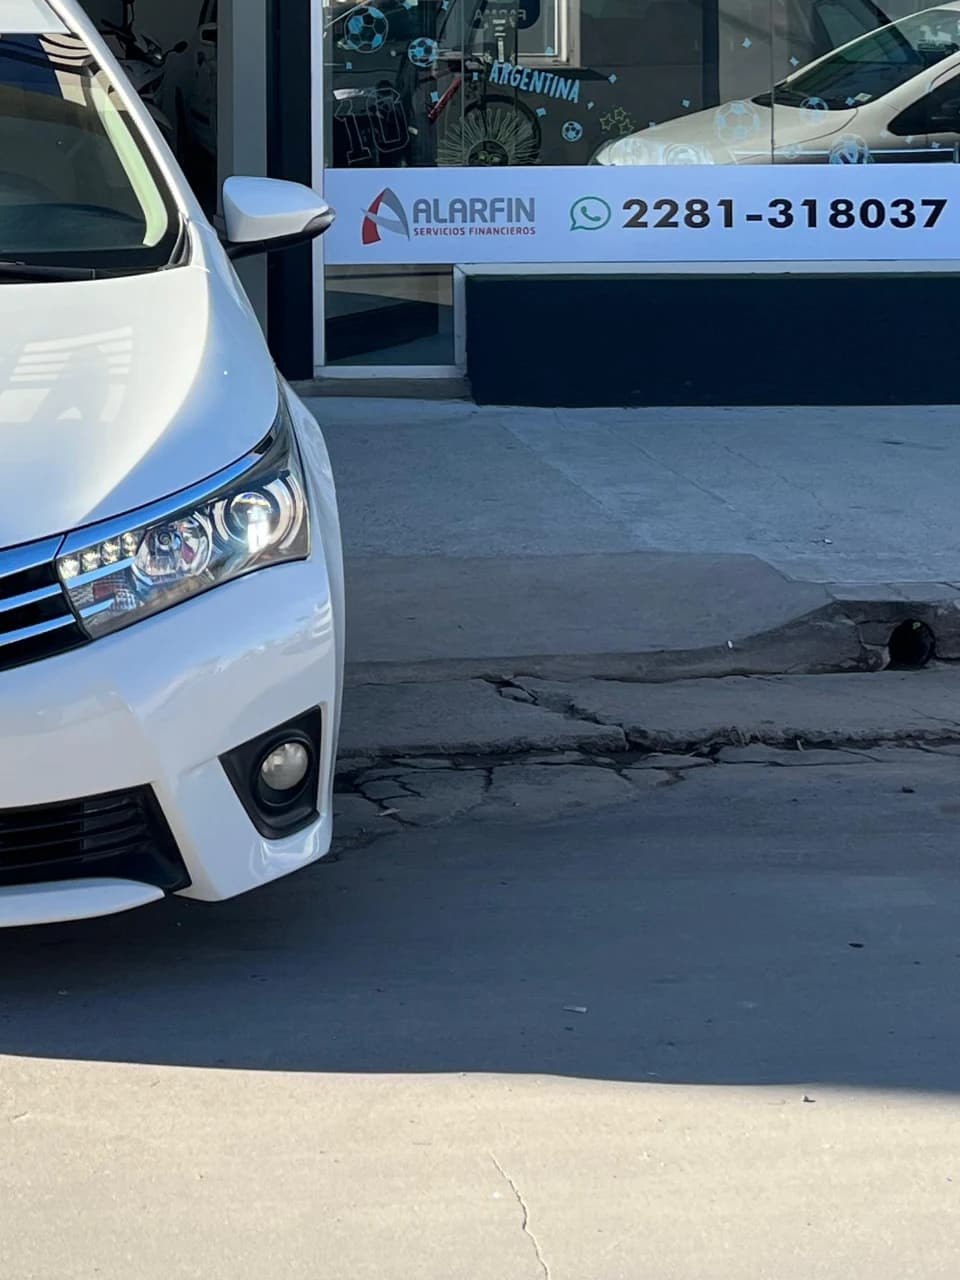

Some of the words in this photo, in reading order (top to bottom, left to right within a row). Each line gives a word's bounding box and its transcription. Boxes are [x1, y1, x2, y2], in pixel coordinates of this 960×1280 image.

[488, 59, 581, 104] ARGENTINA
[413, 197, 536, 224] ALARFIN
[622, 198, 948, 230] 2281-318037
[413, 227, 466, 237] SERVICIOS
[469, 227, 536, 236] FINANCIEROS
